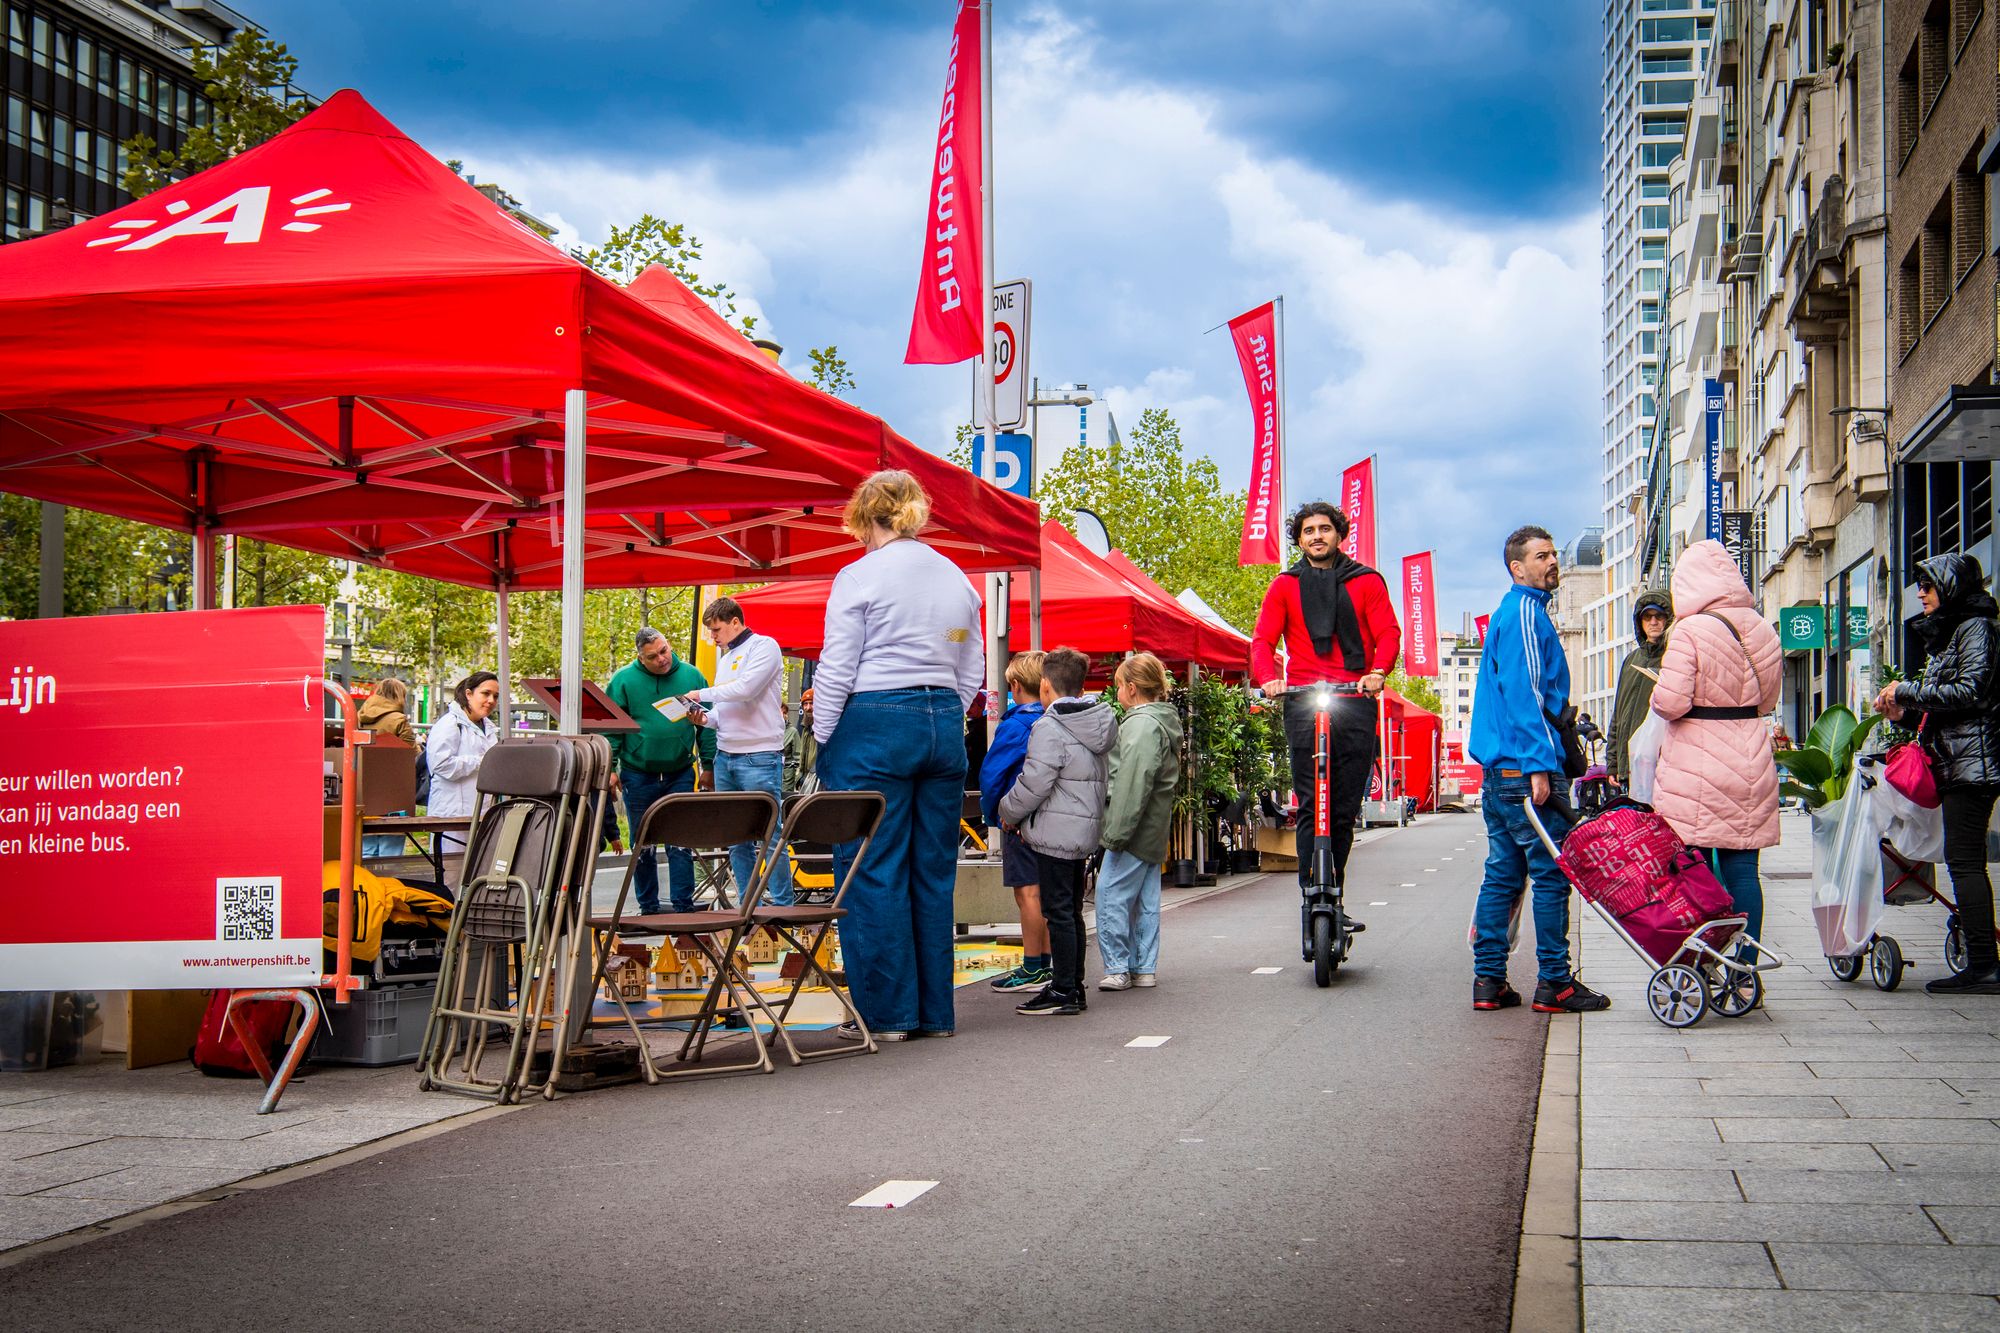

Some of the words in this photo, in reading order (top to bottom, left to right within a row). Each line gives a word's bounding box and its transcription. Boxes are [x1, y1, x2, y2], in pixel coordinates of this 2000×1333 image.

[994, 292, 1014, 311] ONE
[1712, 484, 1720, 533] STUDENT
[35, 769, 92, 790] willen
[99, 766, 184, 788] worden?
[34, 802, 52, 826] jij
[57, 799, 139, 824] vandaag
[145, 802, 181, 818] een
[1319, 783, 1327, 830] POPPY
[0, 839, 22, 854] en
[29, 833, 85, 854] kleine
[91, 832, 131, 852] bus.
[183, 954, 311, 968] www.antwerpenshift.be
